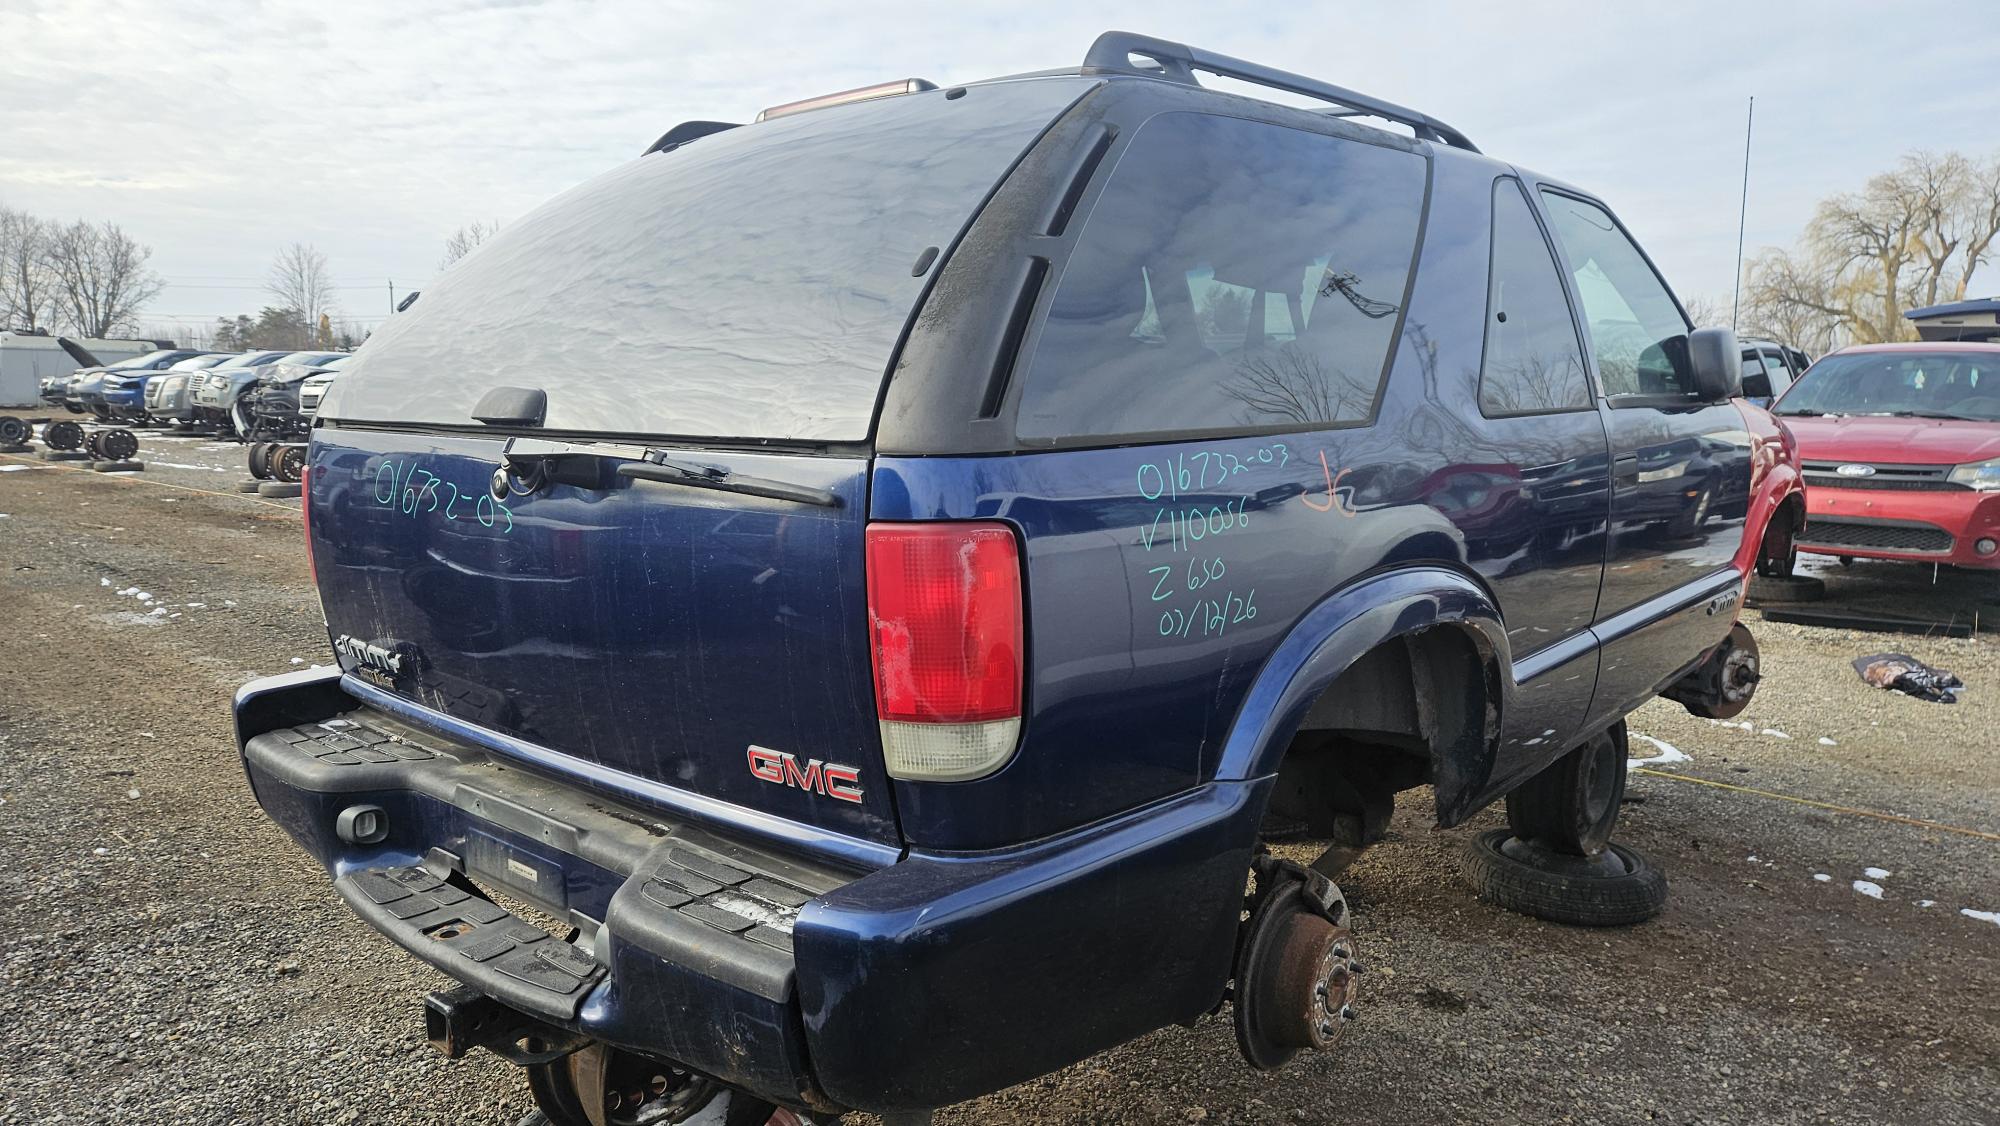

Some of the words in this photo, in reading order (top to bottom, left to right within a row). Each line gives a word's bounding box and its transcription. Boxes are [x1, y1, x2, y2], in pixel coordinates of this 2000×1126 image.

[374, 459, 514, 534] 016732-03
[1137, 443, 1289, 502] 016732-03
[746, 744, 865, 805] GMC
